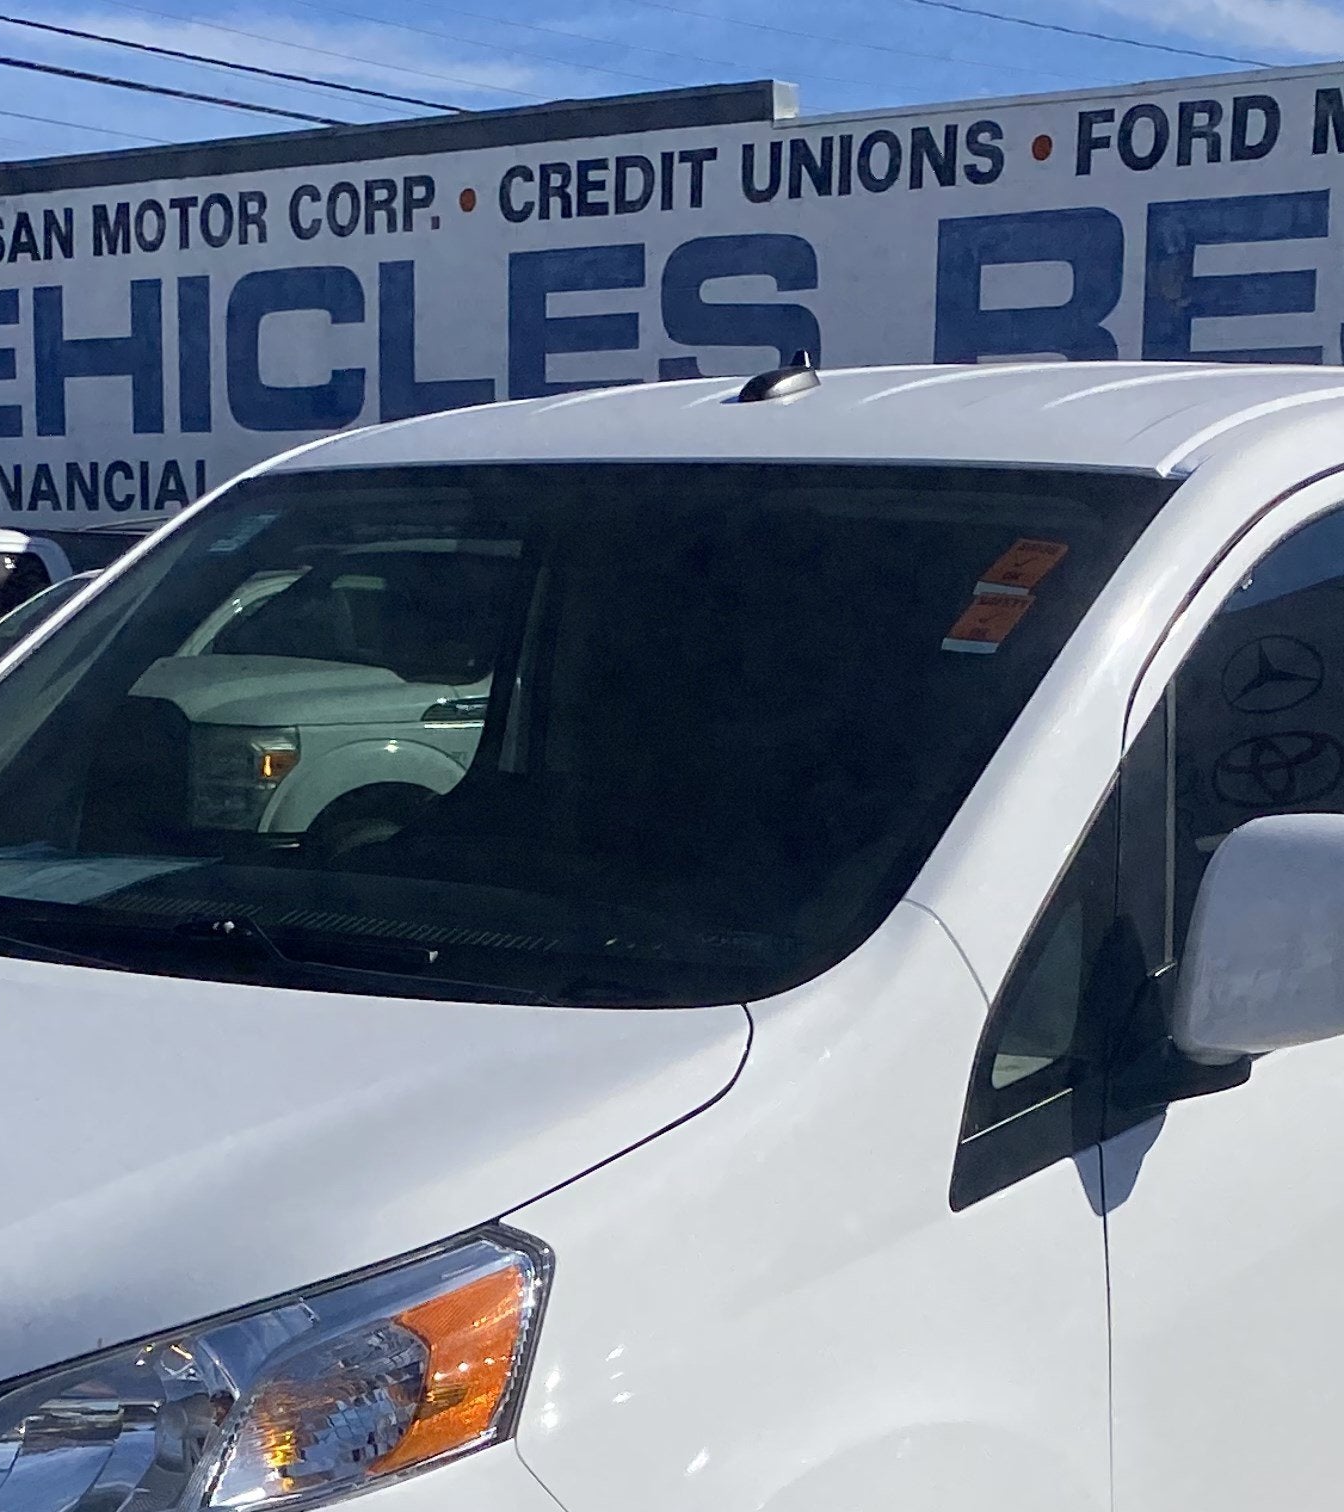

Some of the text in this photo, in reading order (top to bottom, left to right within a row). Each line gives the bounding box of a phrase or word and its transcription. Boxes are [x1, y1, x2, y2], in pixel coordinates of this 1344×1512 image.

[93, 190, 268, 257] MOTOR
[289, 174, 440, 241] CORP.
[499, 147, 718, 223] CREDIT
[741, 119, 1005, 205] UNIONS
[1074, 94, 1281, 176] FORD
